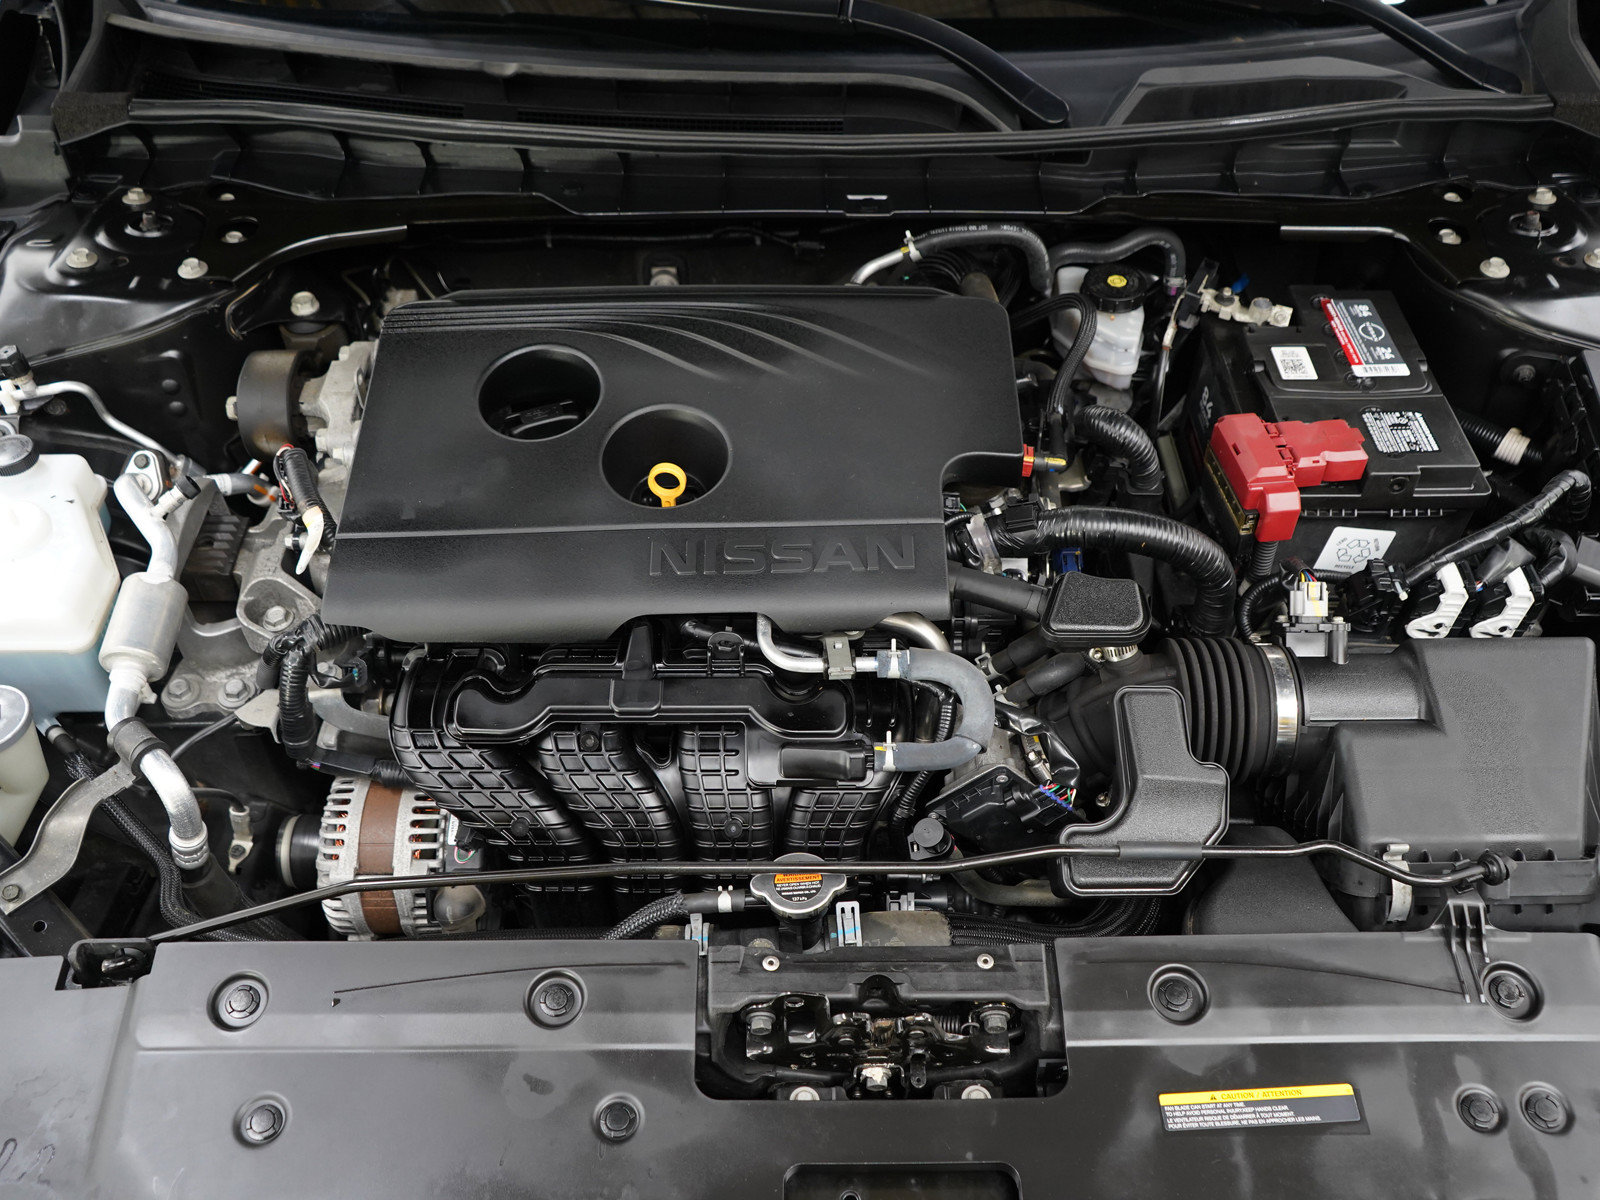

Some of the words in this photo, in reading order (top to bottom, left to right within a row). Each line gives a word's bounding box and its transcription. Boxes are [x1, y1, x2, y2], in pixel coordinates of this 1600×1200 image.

[649, 535, 916, 576] NISSAN
[1221, 1092, 1254, 1100] CAUTION
[1262, 1090, 1302, 1098] ATTENTION
